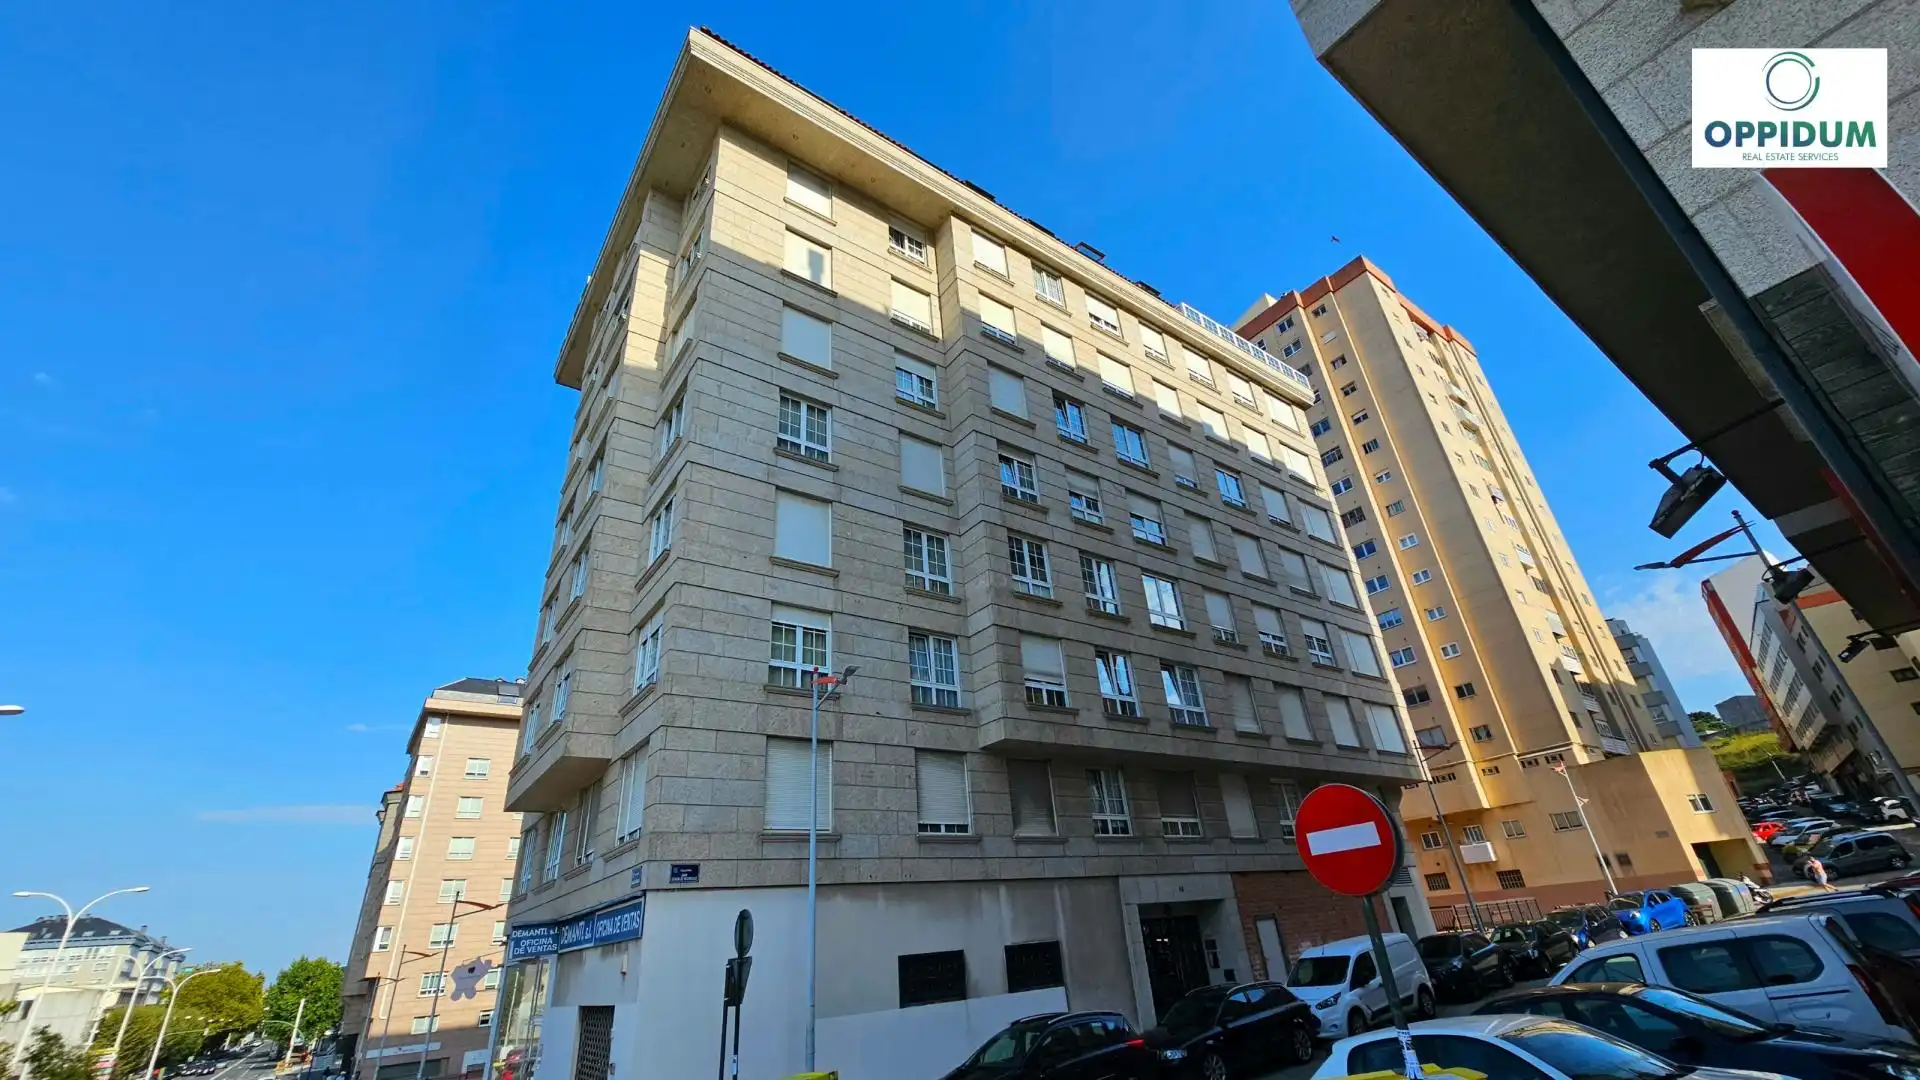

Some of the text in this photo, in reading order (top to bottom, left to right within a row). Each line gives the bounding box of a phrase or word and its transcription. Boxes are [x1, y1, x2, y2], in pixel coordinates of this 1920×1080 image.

[596, 911, 641, 938] OFICINA DE VENTAS
[520, 937, 553, 947] OFICINA
[514, 944, 558, 955] DE VENTAS
